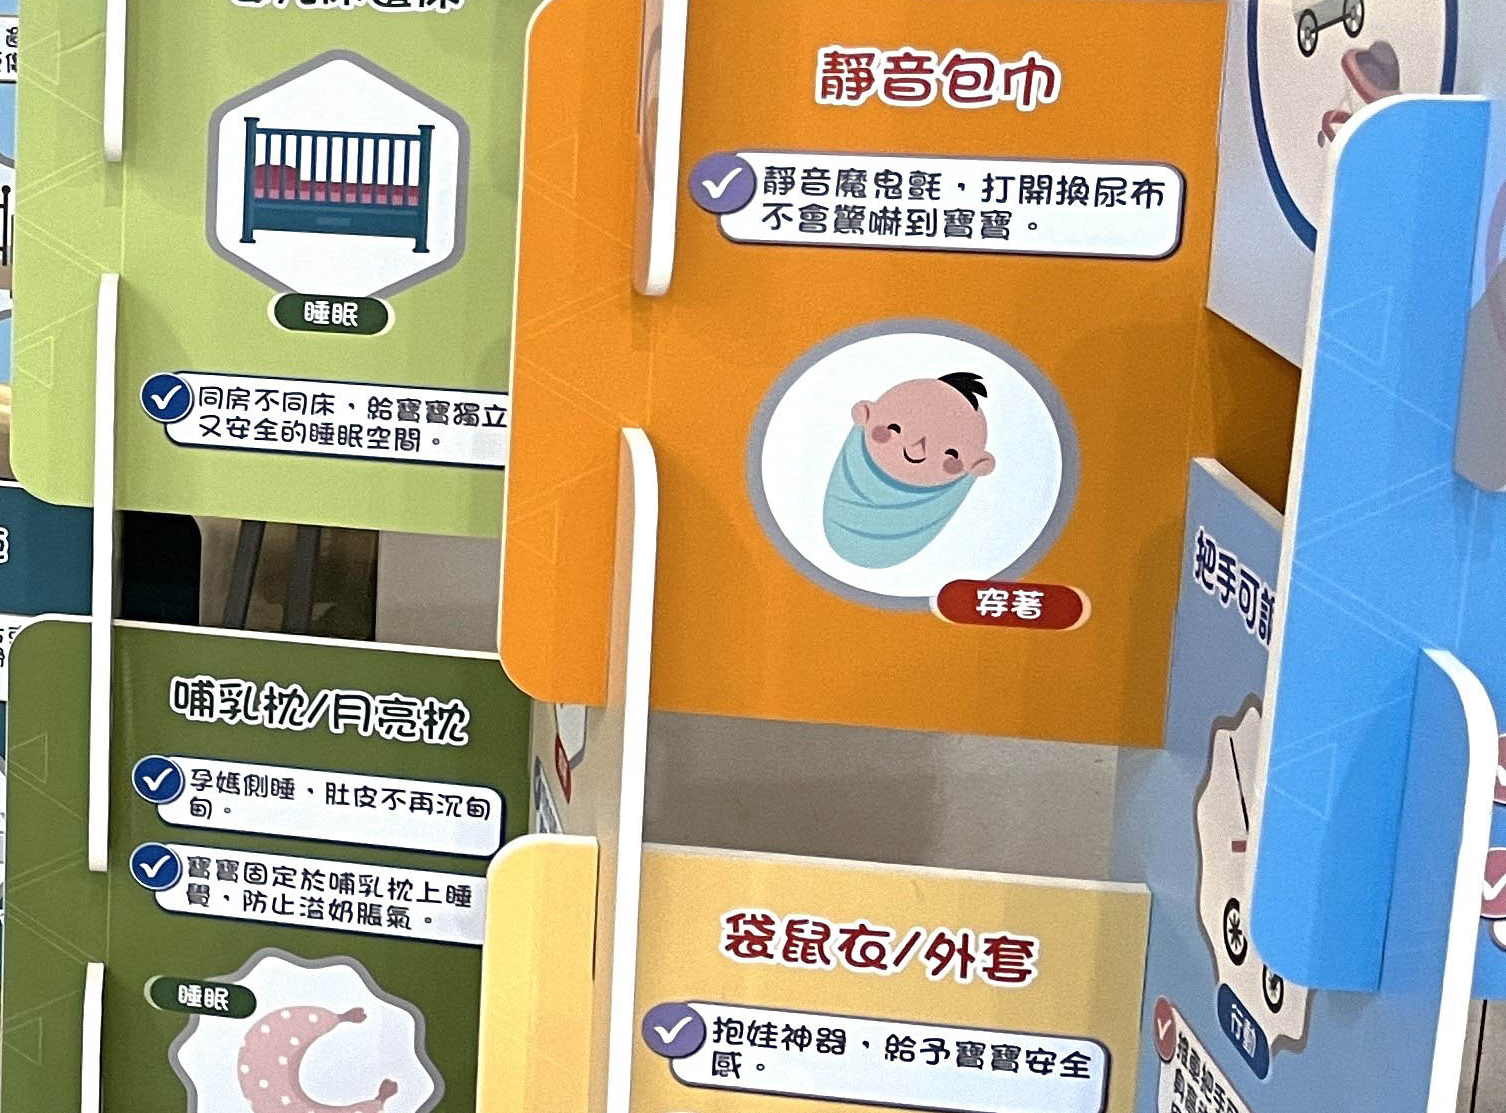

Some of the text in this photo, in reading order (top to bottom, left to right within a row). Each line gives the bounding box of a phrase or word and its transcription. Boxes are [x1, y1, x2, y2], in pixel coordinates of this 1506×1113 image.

[820, 50, 1059, 108] 靜音包巾
[762, 165, 1166, 210] 靜音魔鬼氈，打開換尿布
[760, 202, 1040, 241] 不會驚嚇到寶寶。
[304, 301, 358, 328] 睡眠
[198, 386, 508, 429] 同房不同床，給寶寶獨立
[199, 414, 441, 453] 又安全的睡眠空間。
[976, 588, 1044, 620] 穿著
[173, 679, 469, 744] 哺乳枕/月亮枕
[190, 769, 491, 821] 孕媽側睡，肚皮不再沉甸
[187, 855, 472, 908] 寶寶固定於哺乳枕上睡
[724, 912, 1040, 984] 袋鼠衣/外套
[178, 984, 229, 1013] 睡眠
[711, 1051, 766, 1079] 感。
[712, 1017, 1092, 1080] 抱娃神器，給予寶寶安全
